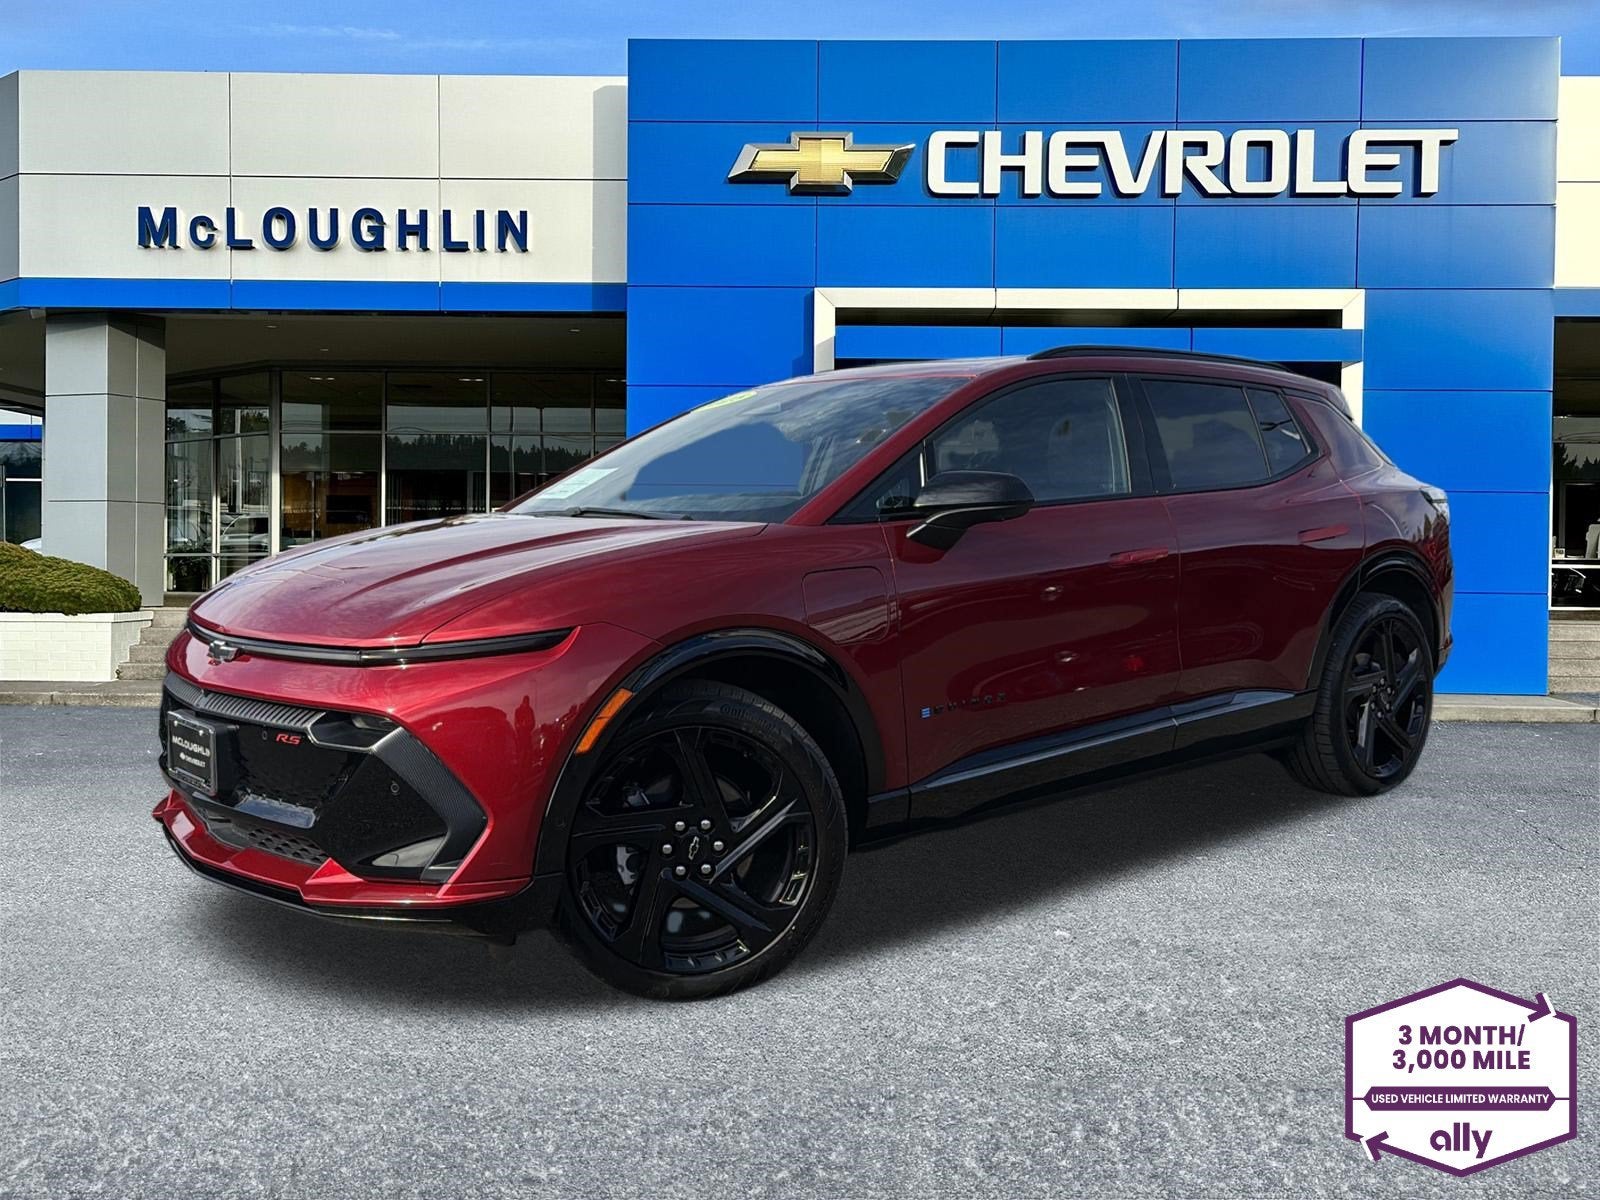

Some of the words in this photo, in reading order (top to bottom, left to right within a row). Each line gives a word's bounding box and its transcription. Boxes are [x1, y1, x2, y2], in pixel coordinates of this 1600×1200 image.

[928, 129, 1459, 196] CHEVROLET
[138, 206, 529, 252] McLOUGHLIN
[276, 733, 301, 745] RS
